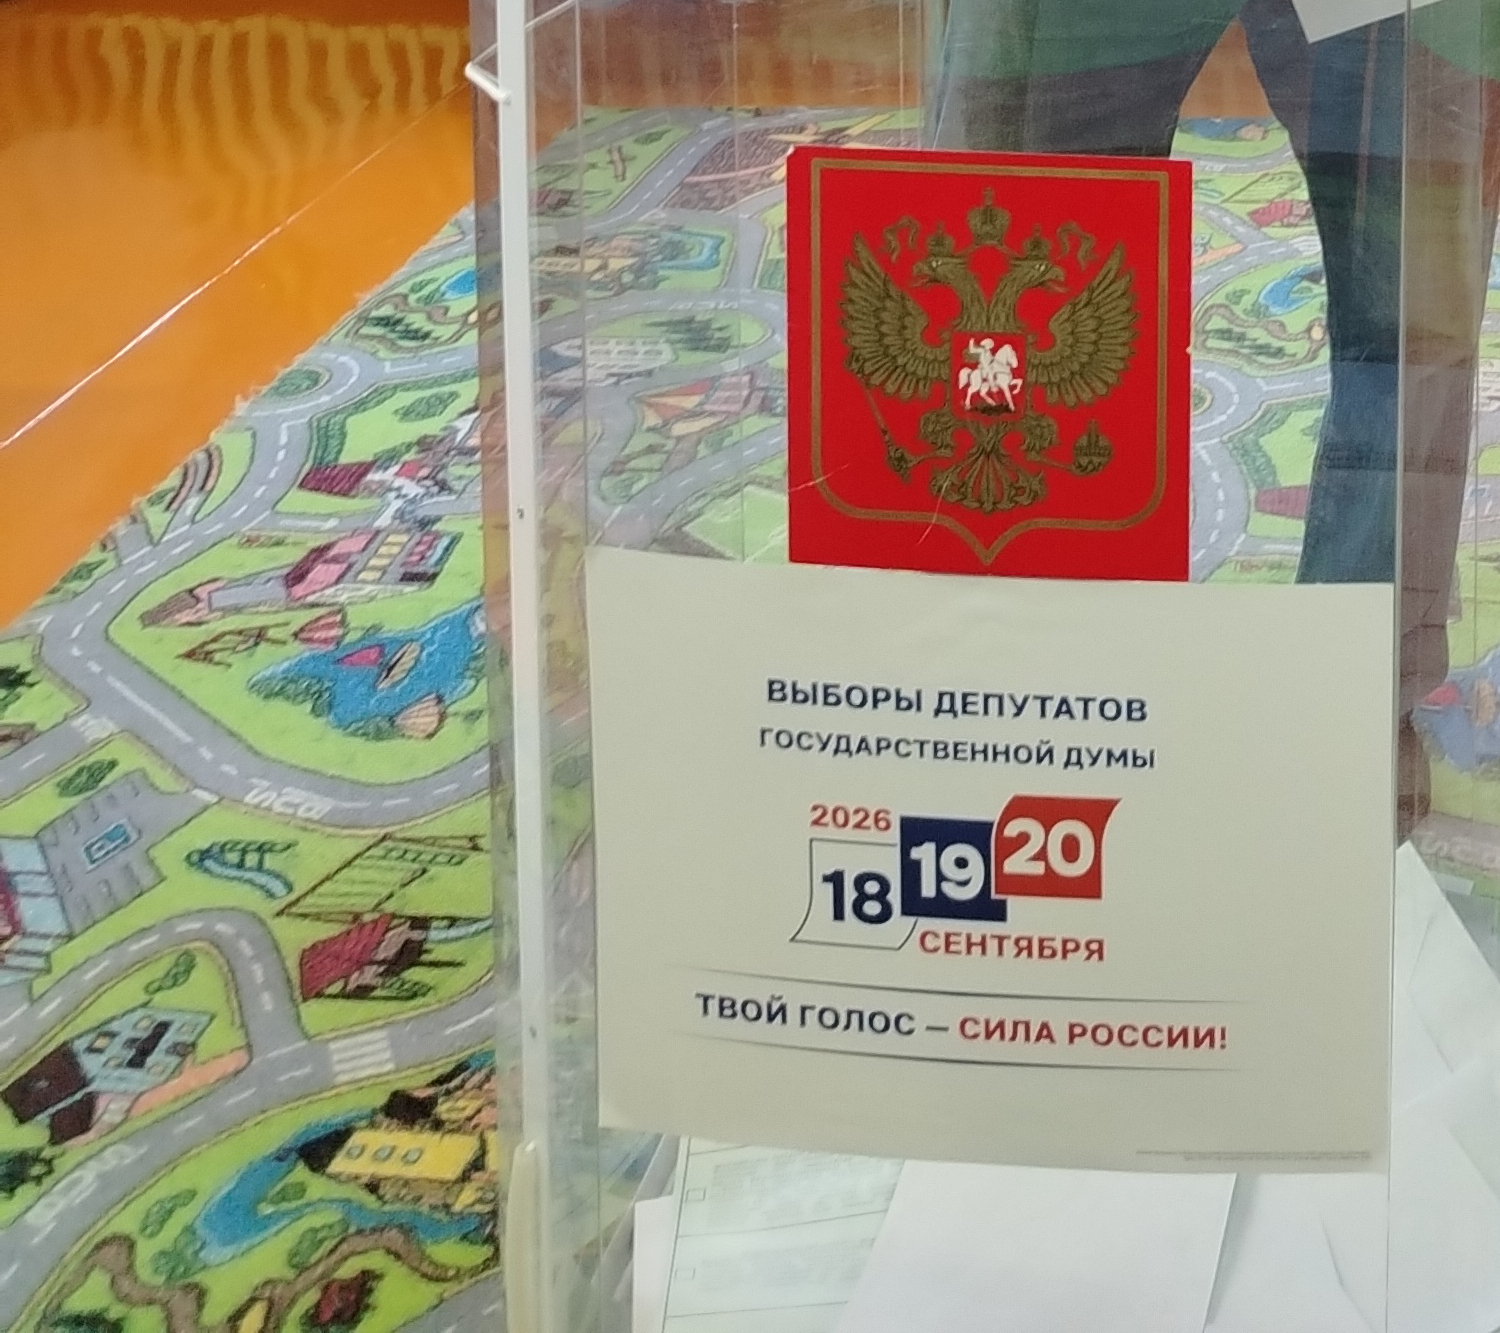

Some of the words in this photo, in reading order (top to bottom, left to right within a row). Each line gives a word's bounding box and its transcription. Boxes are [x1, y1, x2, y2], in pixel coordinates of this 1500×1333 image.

[766, 678, 923, 713] ВЫБОРЫ
[932, 690, 1148, 724] ДЕПУТАТОВ
[759, 727, 1055, 766] ГОСУДАРСТВЕННОЙ
[1062, 744, 1156, 771] ДУМЫ
[809, 804, 892, 832] 2026
[821, 868, 894, 925] 18
[909, 841, 986, 901] 19
[1002, 816, 1096, 878] 20
[918, 930, 1106, 962] СЕНТЯБРЯ
[695, 992, 788, 1026] ТВОЙ
[799, 1004, 916, 1037] ГОЛОС
[959, 1015, 1057, 1044] СИЛА
[1068, 1023, 1228, 1050] РОССИИ!
